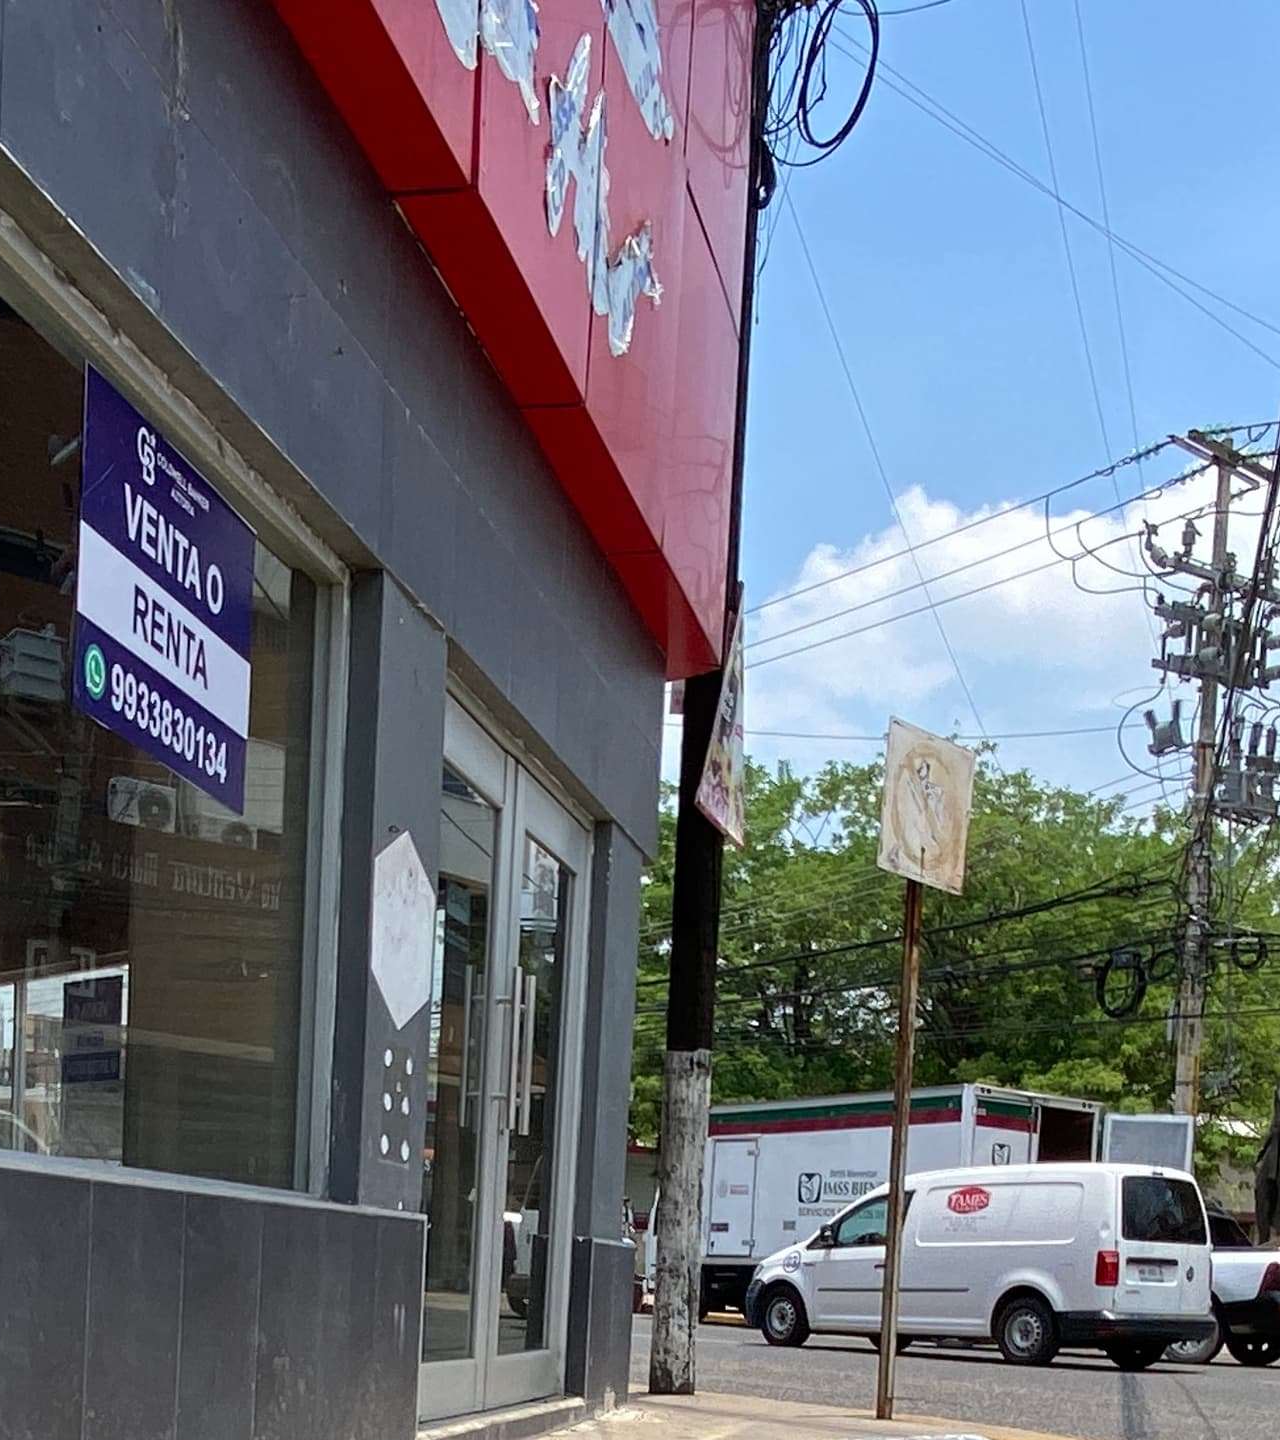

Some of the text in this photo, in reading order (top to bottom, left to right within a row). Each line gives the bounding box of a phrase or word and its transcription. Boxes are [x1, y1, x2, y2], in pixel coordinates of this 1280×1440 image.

[124, 482, 224, 616] VENTA O
[133, 584, 208, 691] RENTA
[111, 663, 226, 784] 9933830134
